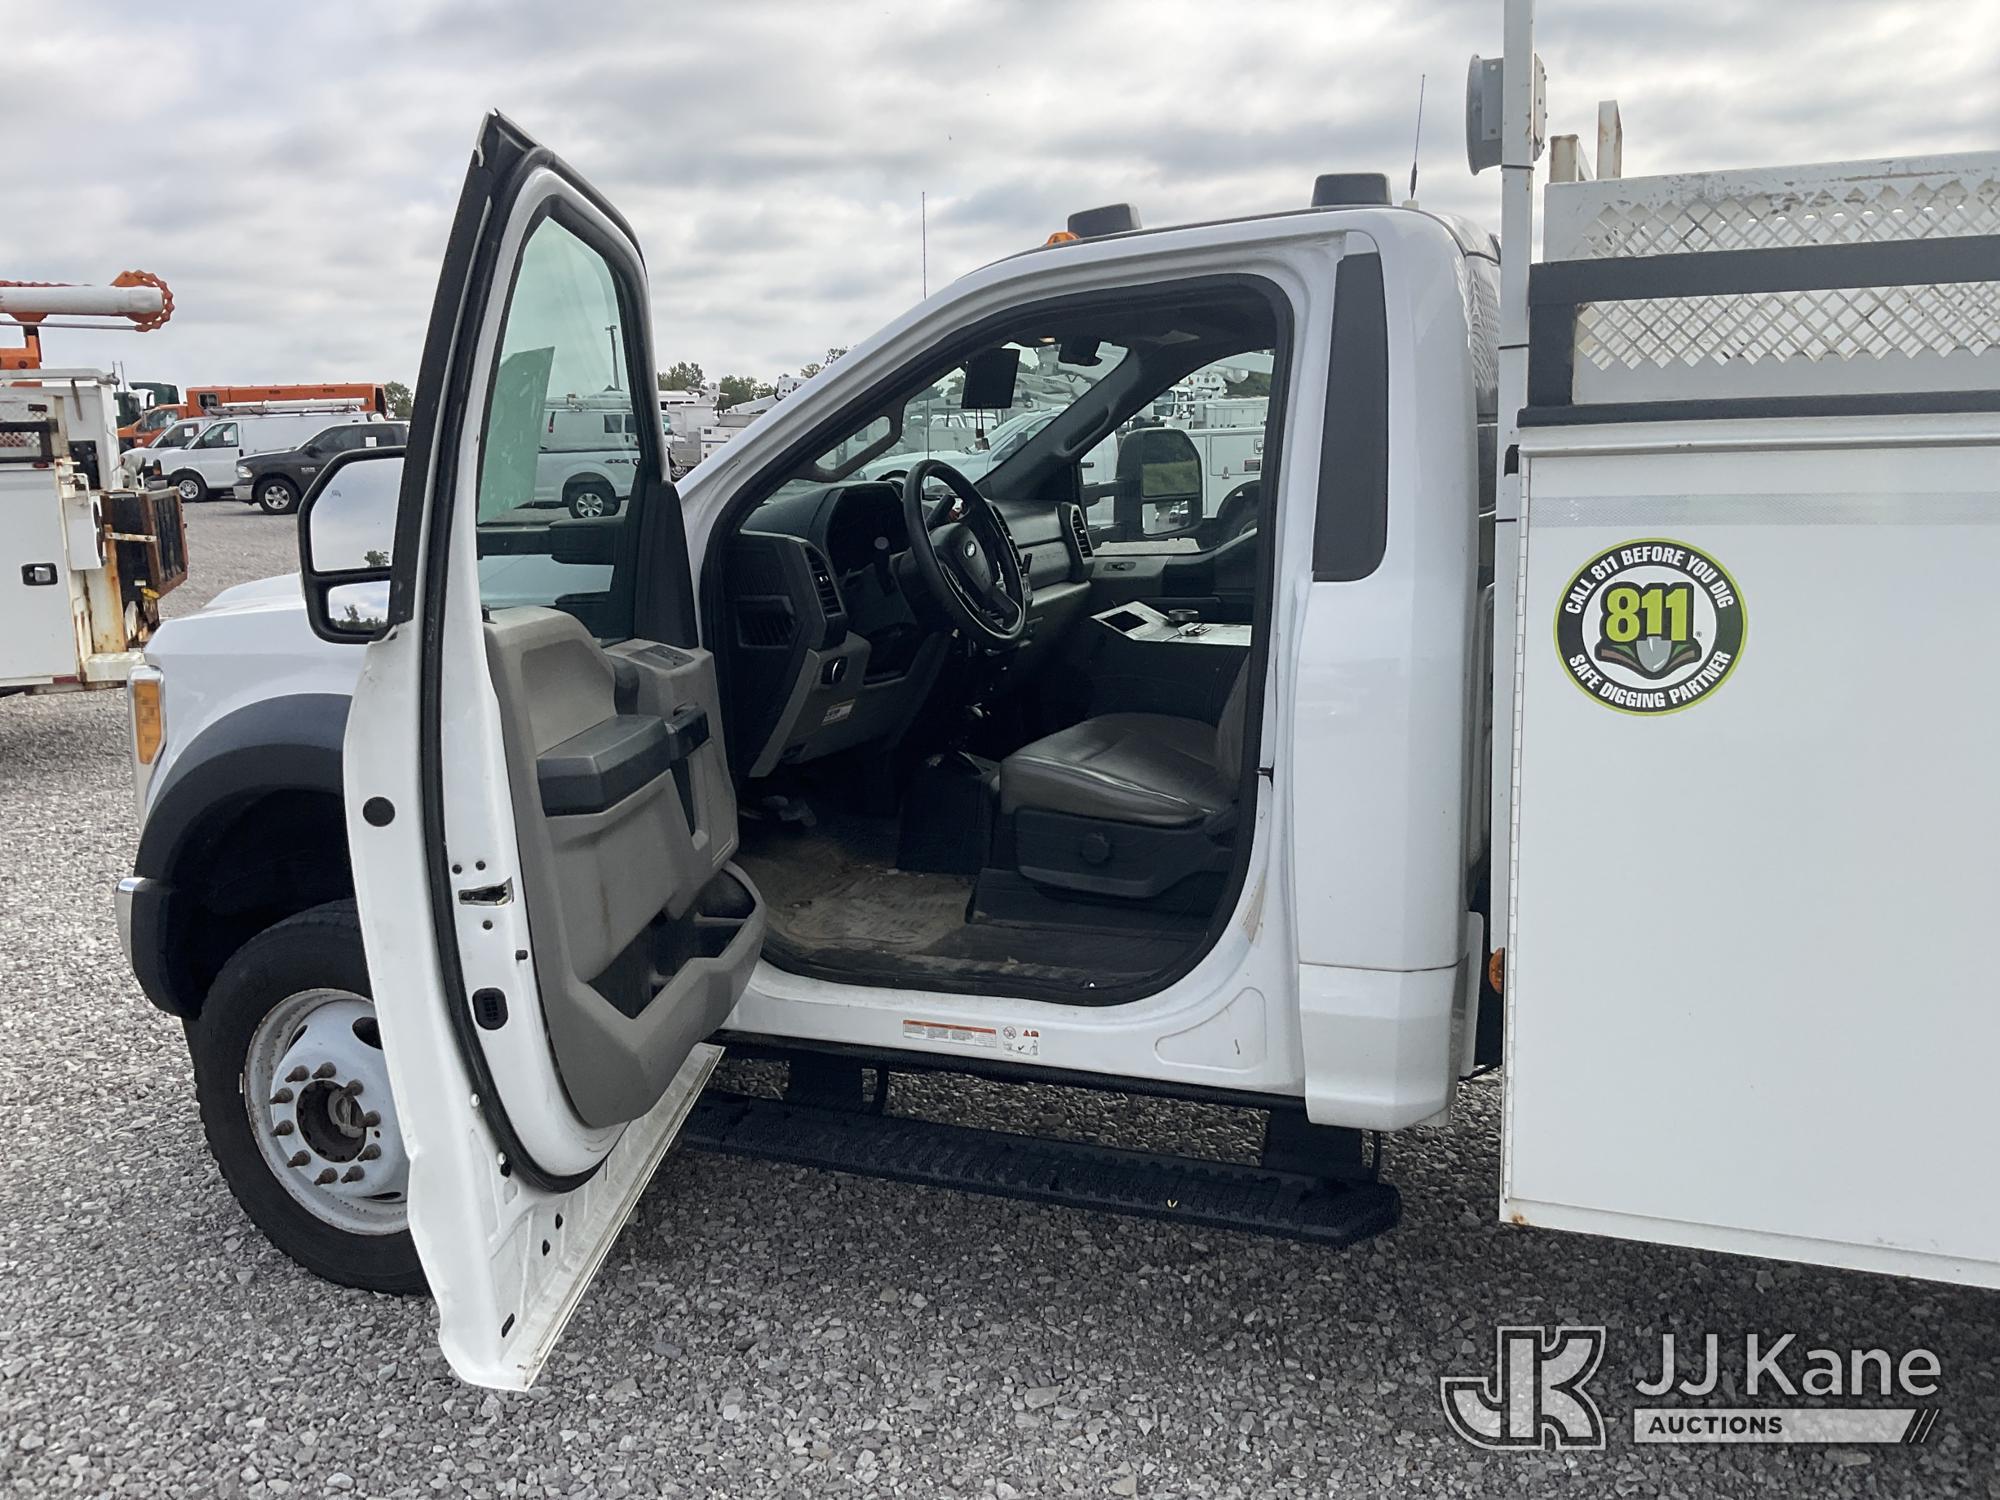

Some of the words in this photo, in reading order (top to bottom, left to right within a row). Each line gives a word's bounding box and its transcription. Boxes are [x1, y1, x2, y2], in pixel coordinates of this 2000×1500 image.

[1565, 578, 1597, 615] CALL
[1590, 556, 1620, 581] 811
[1621, 546, 1687, 567] BEFORE
[1685, 554, 1718, 584] YOU
[1708, 580, 1735, 609] DIG
[1605, 587, 1689, 643] 811
[1569, 653, 1603, 691] SAFE
[1598, 682, 1666, 709] DIGGING
[1667, 650, 1732, 706] PARTNER
